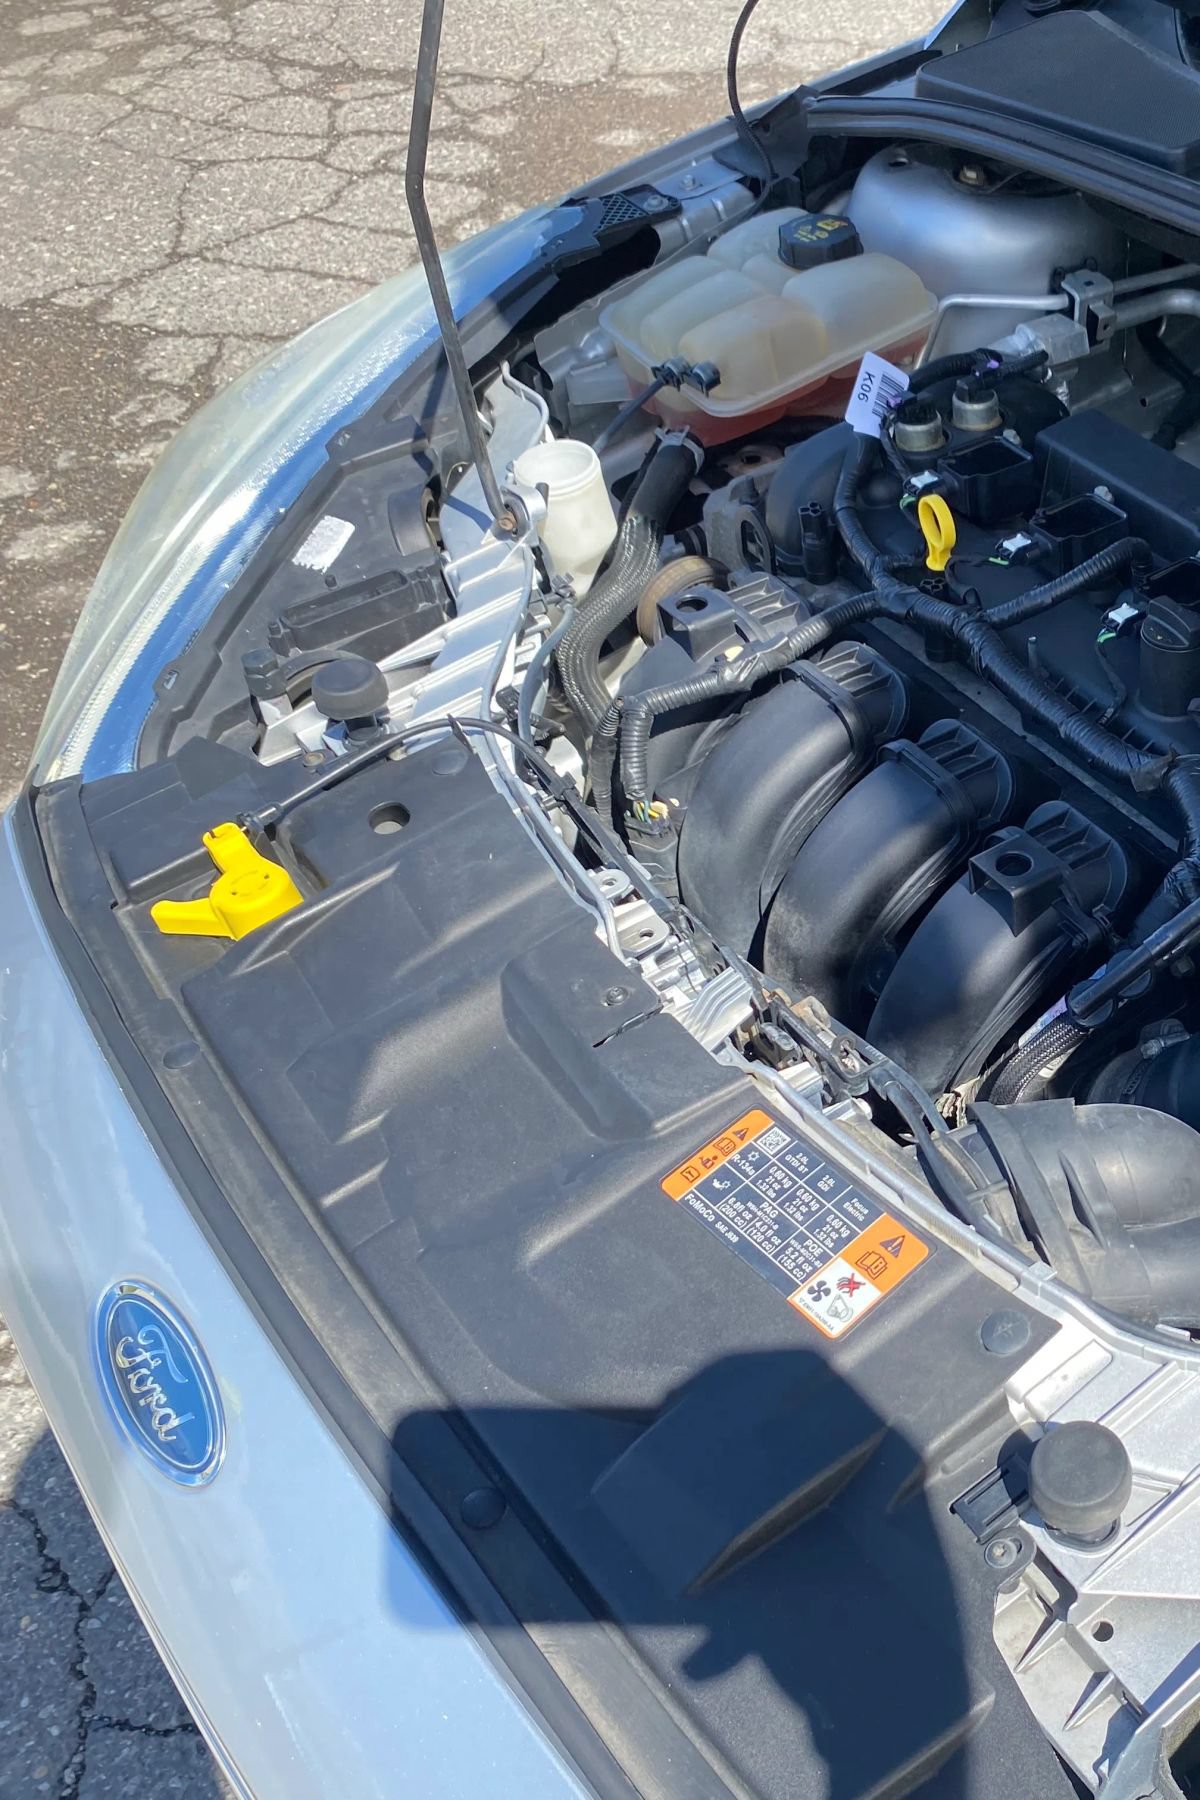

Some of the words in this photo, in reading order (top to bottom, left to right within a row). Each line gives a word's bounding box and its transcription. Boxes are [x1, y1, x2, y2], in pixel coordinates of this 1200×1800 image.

[857, 371, 876, 403] K06
[731, 1154, 756, 1175] R-134a
[795, 1152, 810, 1164] 2.0L
[768, 1165, 785, 1180] 0.60
[780, 1176, 793, 1188] kg
[797, 1164, 808, 1174] ST
[755, 1179, 768, 1191] 1.32
[765, 1188, 777, 1198] lbs
[765, 1175, 775, 1184] 21
[771, 1182, 780, 1190] oz
[816, 1180, 830, 1191] GDI
[792, 1198, 802, 1206] 21
[798, 1204, 808, 1213] oz
[795, 1187, 812, 1202] 0.60
[807, 1199, 821, 1211] kg
[850, 1198, 869, 1214] Focus
[685, 1193, 716, 1221] FoMoCo
[714, 1221, 728, 1233] SAE
[718, 1202, 736, 1218] (200
[732, 1215, 747, 1228] cc)
[741, 1210, 752, 1220] oz
[759, 1201, 778, 1218] PAG
[782, 1202, 796, 1214] 1.32
[793, 1211, 804, 1221] lbs
[842, 1202, 865, 1221] Electric
[754, 1220, 767, 1232] 4.0
[764, 1228, 774, 1237] fl
[770, 1235, 781, 1245] oz
[822, 1224, 832, 1233] 21
[829, 1231, 838, 1239] oz
[825, 1214, 842, 1229] 0.60
[837, 1225, 851, 1238] kg
[746, 1227, 764, 1242] (120
[760, 1239, 775, 1252] cc)
[803, 1239, 823, 1256] POE
[813, 1228, 826, 1240] 1.32
[823, 1237, 835, 1248] lbs
[777, 1253, 795, 1270] (155
[791, 1267, 806, 1280] cc)
[784, 1246, 798, 1259] 5.2
[795, 1255, 805, 1264] fl
[801, 1262, 812, 1272] oz
[115, 1324, 195, 1442] Ford
